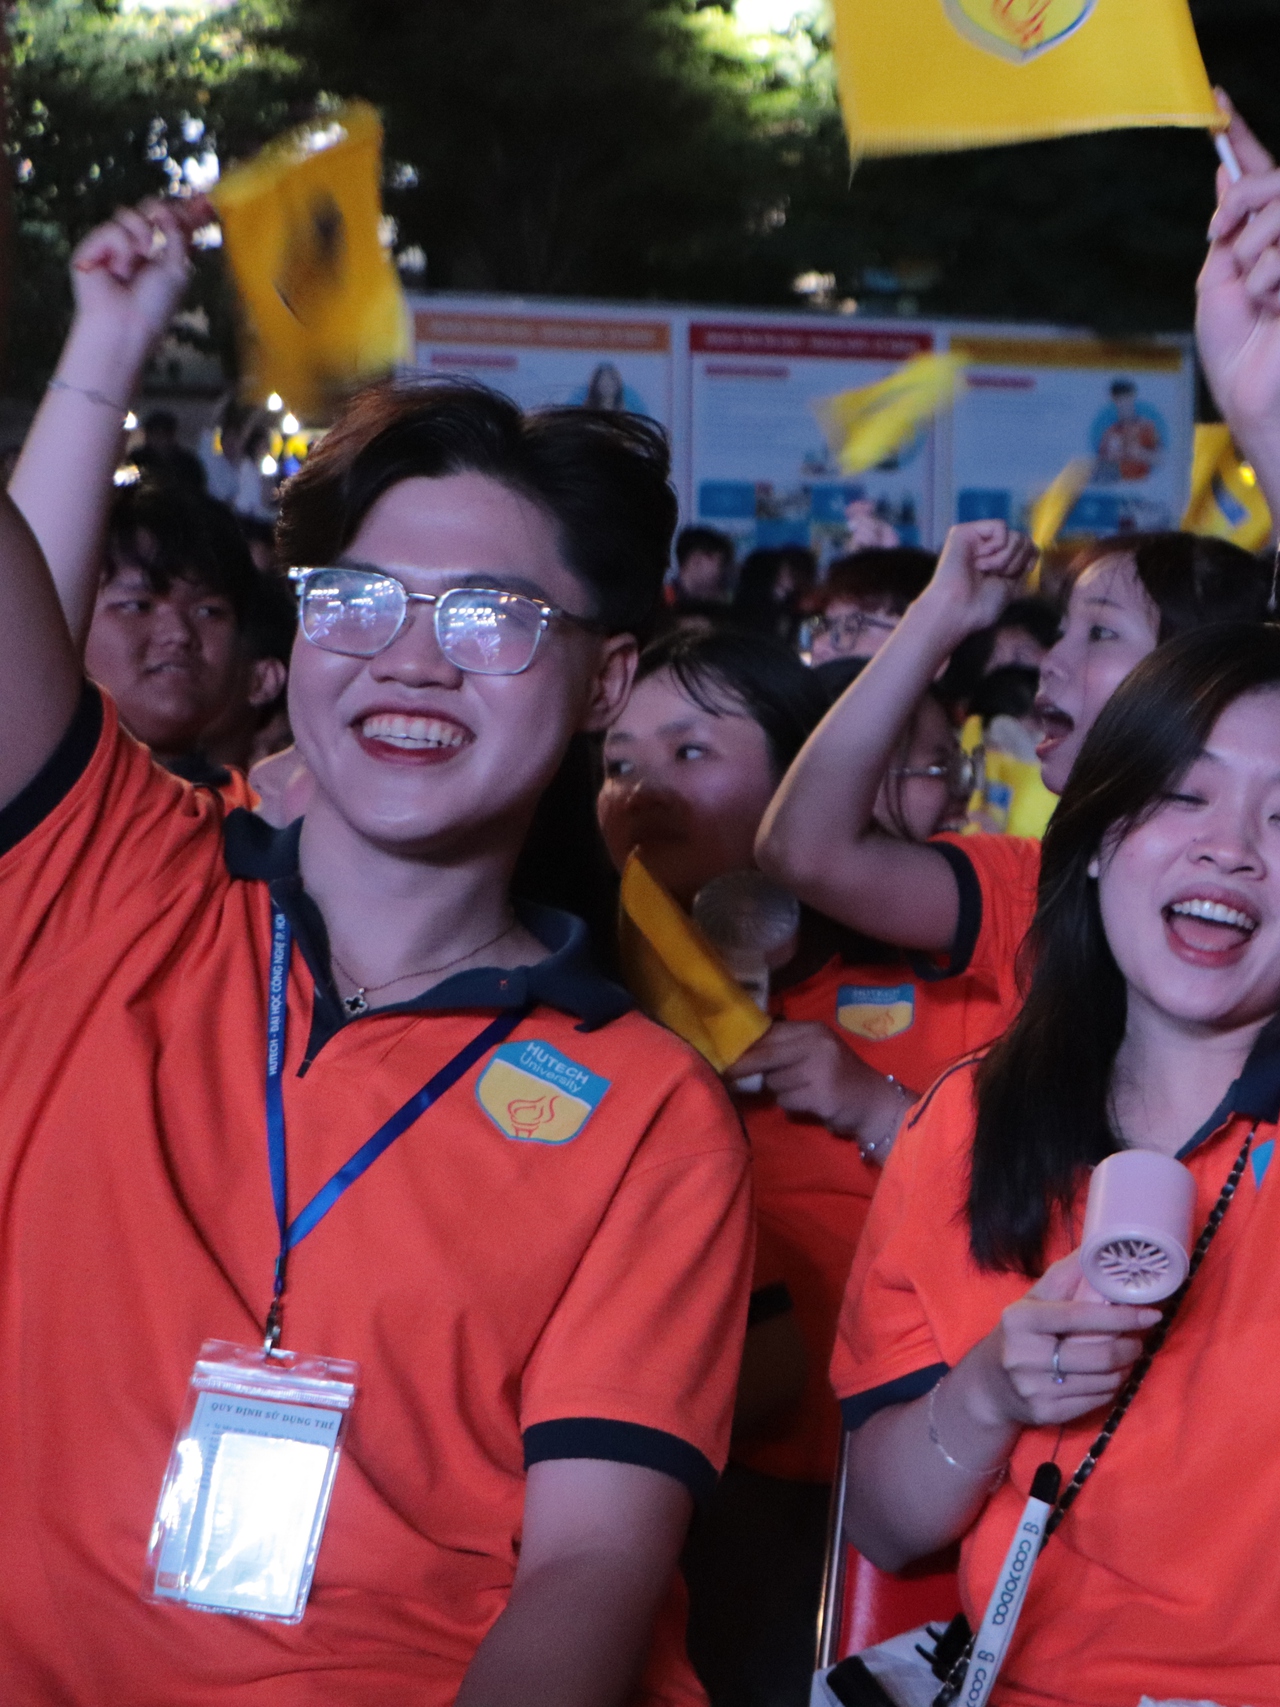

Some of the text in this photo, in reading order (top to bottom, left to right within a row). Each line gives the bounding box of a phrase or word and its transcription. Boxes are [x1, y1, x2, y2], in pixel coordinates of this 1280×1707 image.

[271, 965, 284, 993] CÔNG
[268, 1039, 279, 1076] HUTECH
[520, 1052, 582, 1093] University
[527, 1042, 589, 1084] HUTECH
[211, 1401, 234, 1412] QUY
